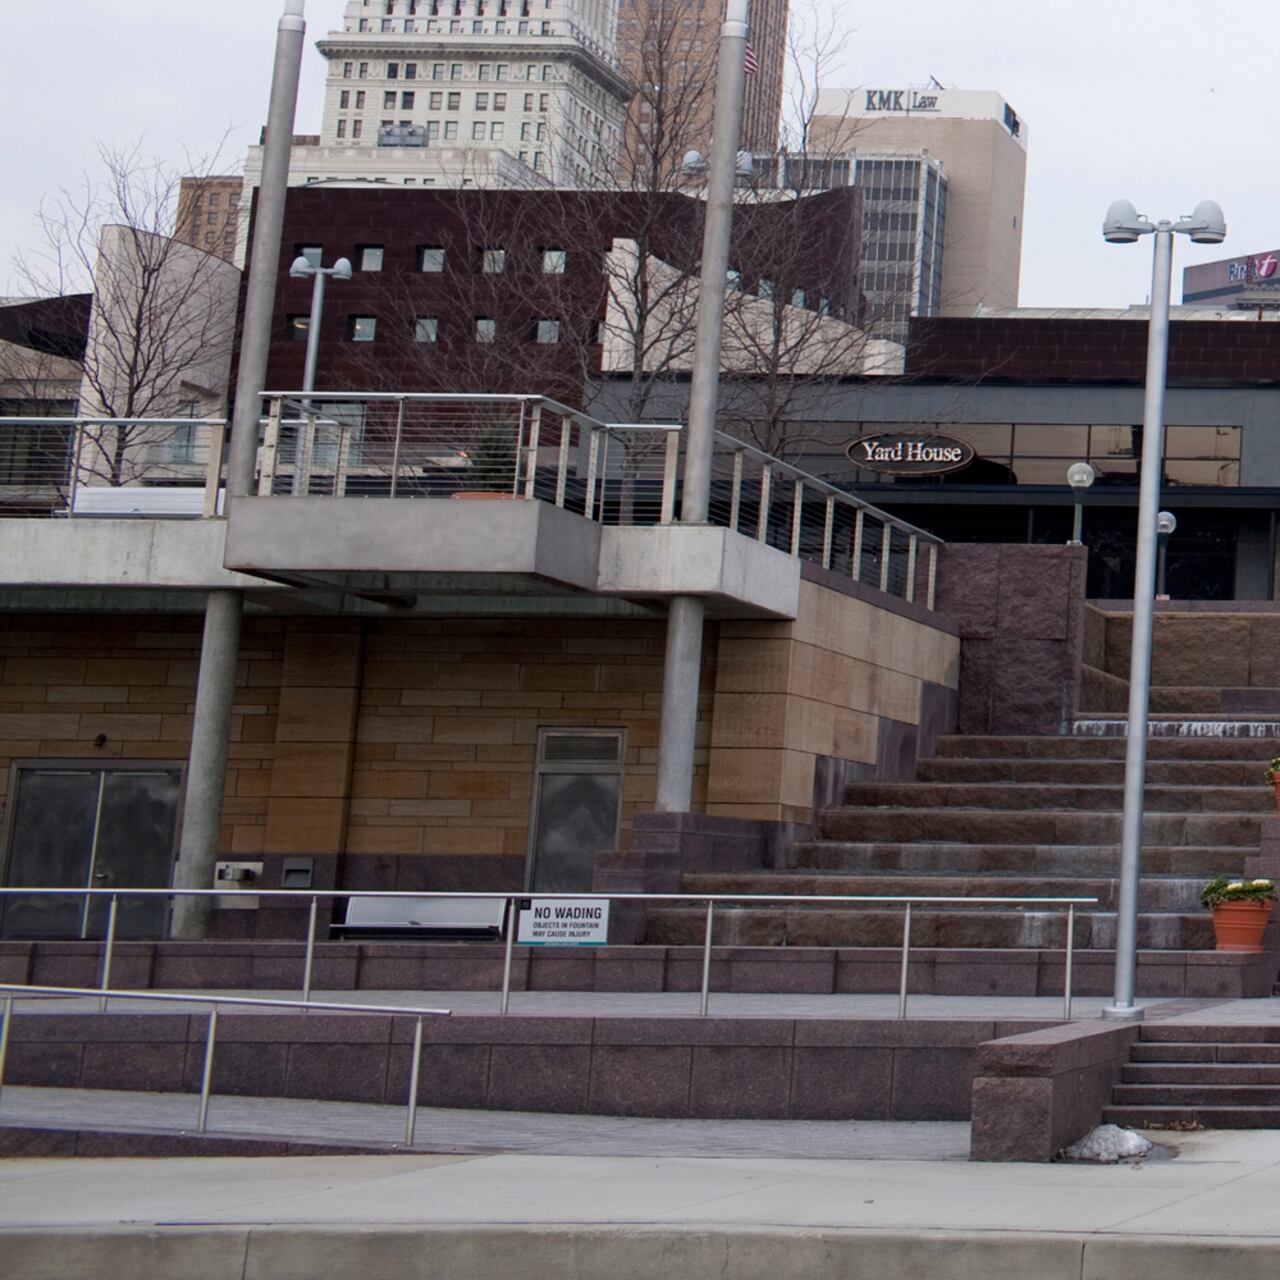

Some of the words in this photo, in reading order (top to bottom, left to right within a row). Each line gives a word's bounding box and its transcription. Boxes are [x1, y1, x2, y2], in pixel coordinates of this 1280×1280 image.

[865, 90, 904, 111] KMK
[913, 92, 938, 109] Law
[862, 442, 903, 461] Yard
[905, 442, 962, 462] House
[534, 907, 551, 919] NO
[555, 907, 602, 919] WADING
